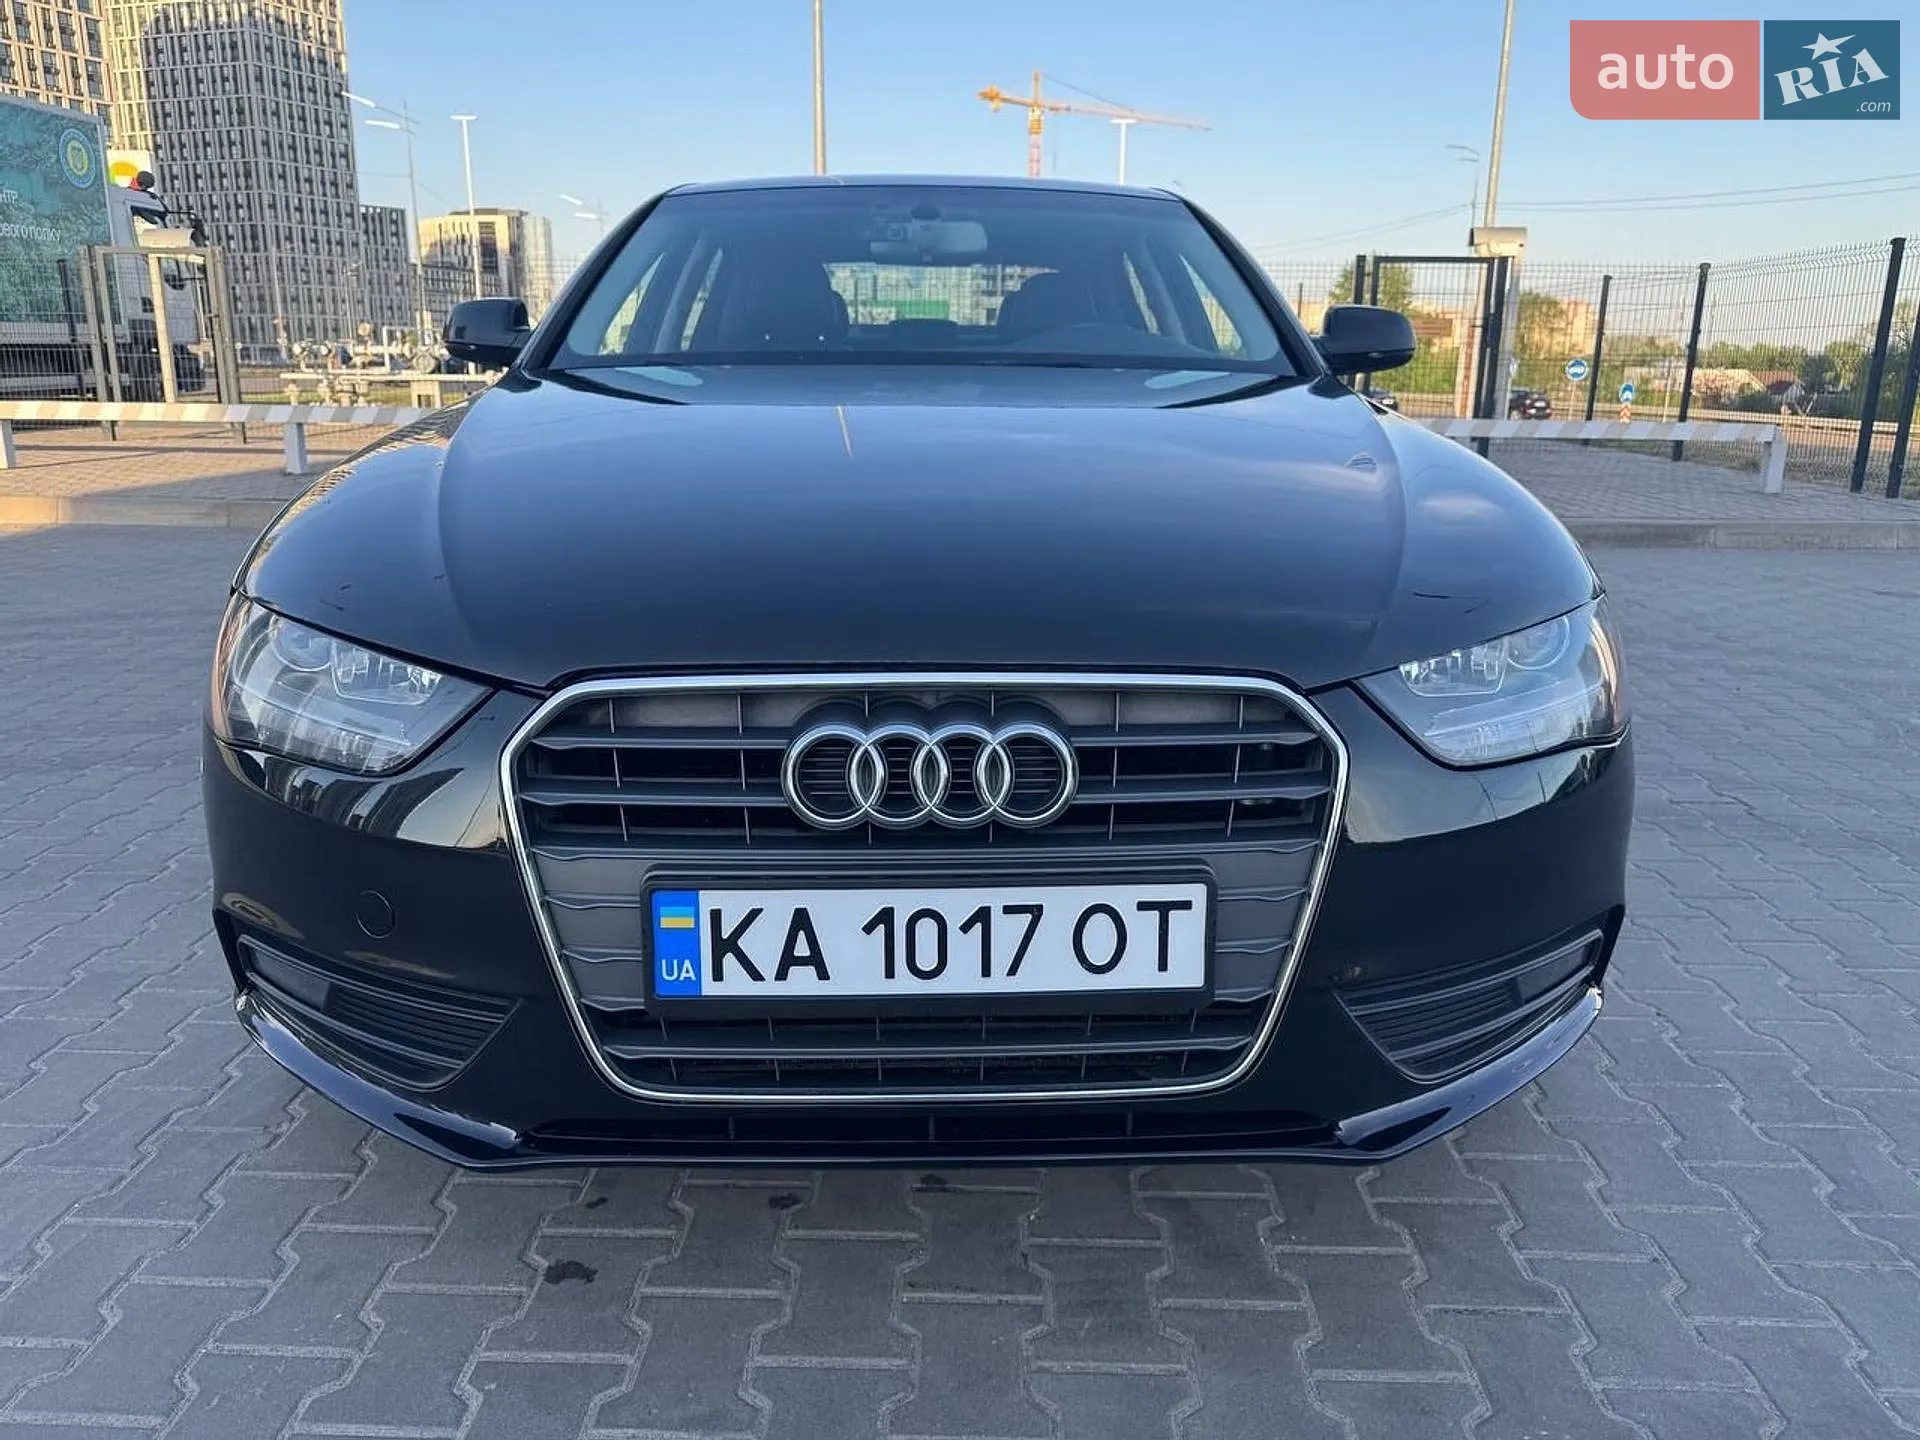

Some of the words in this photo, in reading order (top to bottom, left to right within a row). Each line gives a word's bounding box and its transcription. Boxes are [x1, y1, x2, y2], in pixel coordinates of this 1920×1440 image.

[709, 907, 831, 982] KA
[861, 904, 1044, 980] 1017
[1072, 899, 1193, 975] OT
[661, 959, 697, 982] UA
